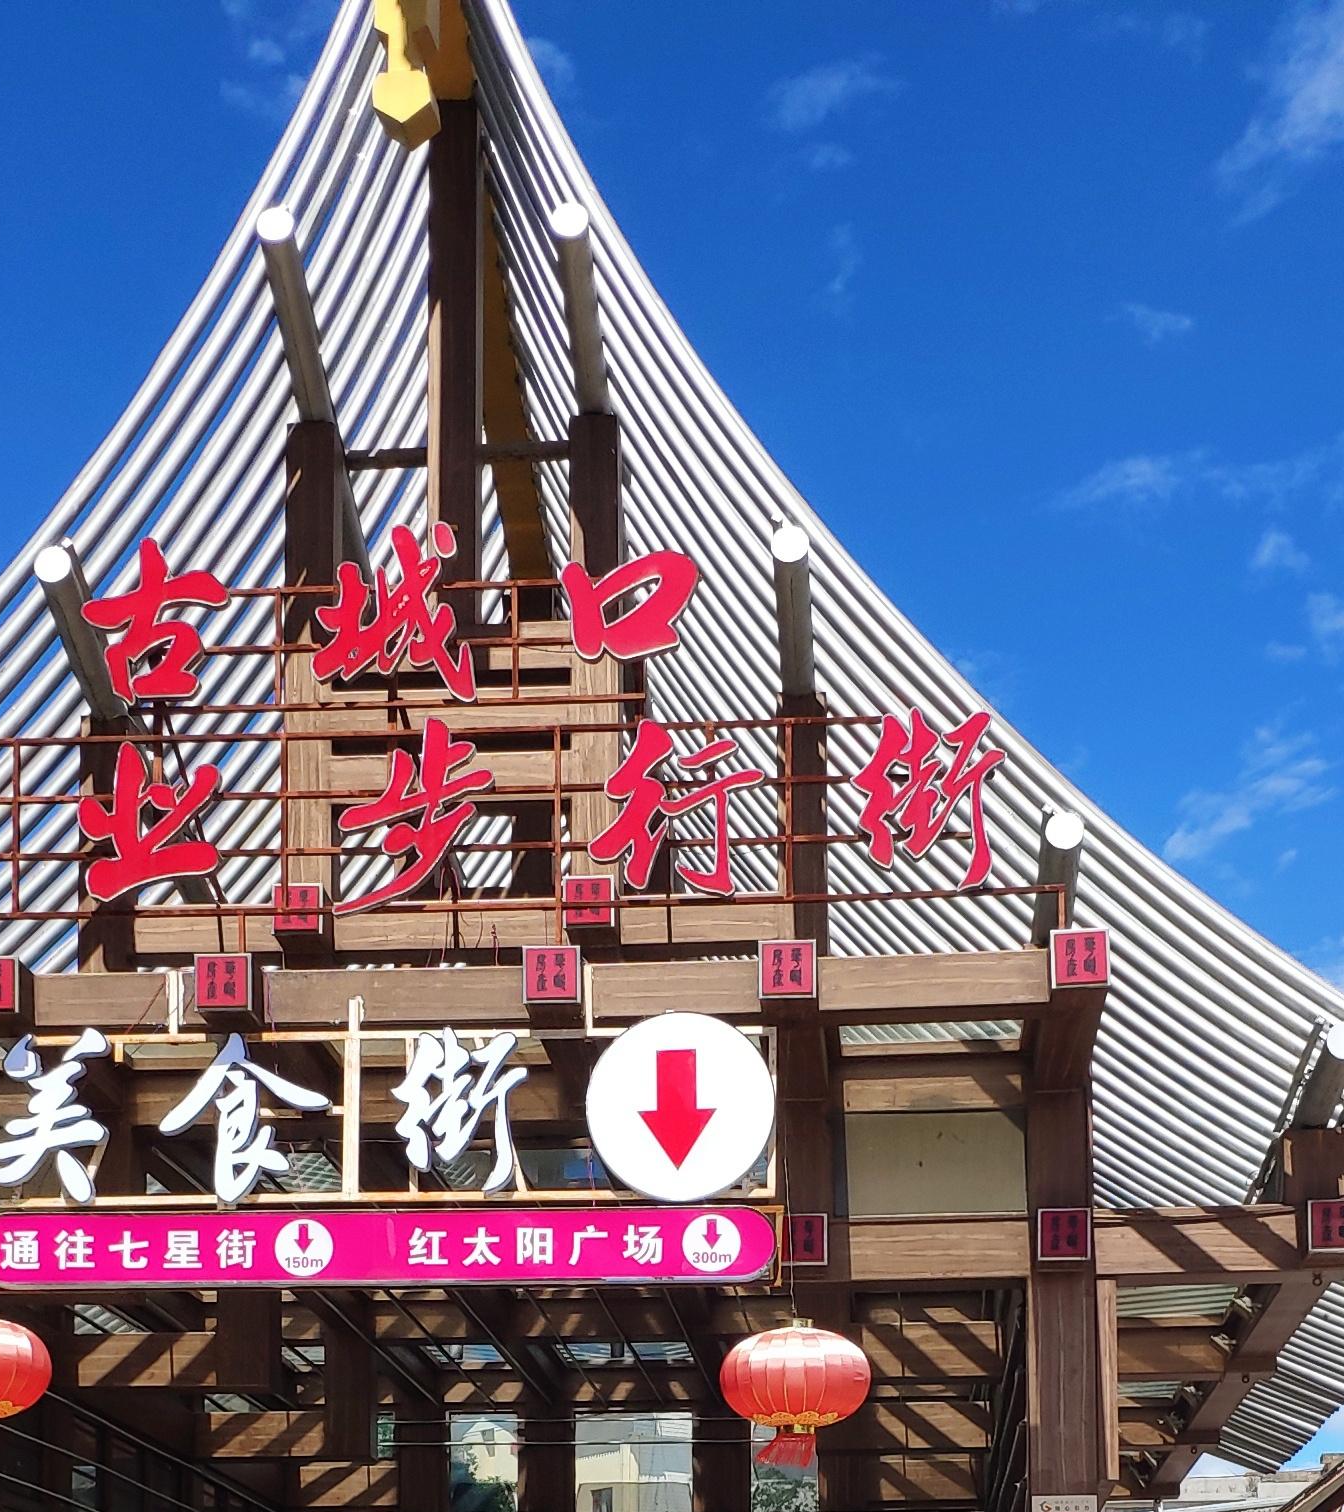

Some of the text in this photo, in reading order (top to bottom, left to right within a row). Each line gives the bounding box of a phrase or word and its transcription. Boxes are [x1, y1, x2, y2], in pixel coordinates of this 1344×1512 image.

[80, 520, 700, 703] 古城口
[0, 1229, 256, 1271] 通往七星街
[284, 1256, 324, 1269] 150m
[407, 1225, 663, 1267] 红太阳广场
[692, 1251, 732, 1264] 300m
